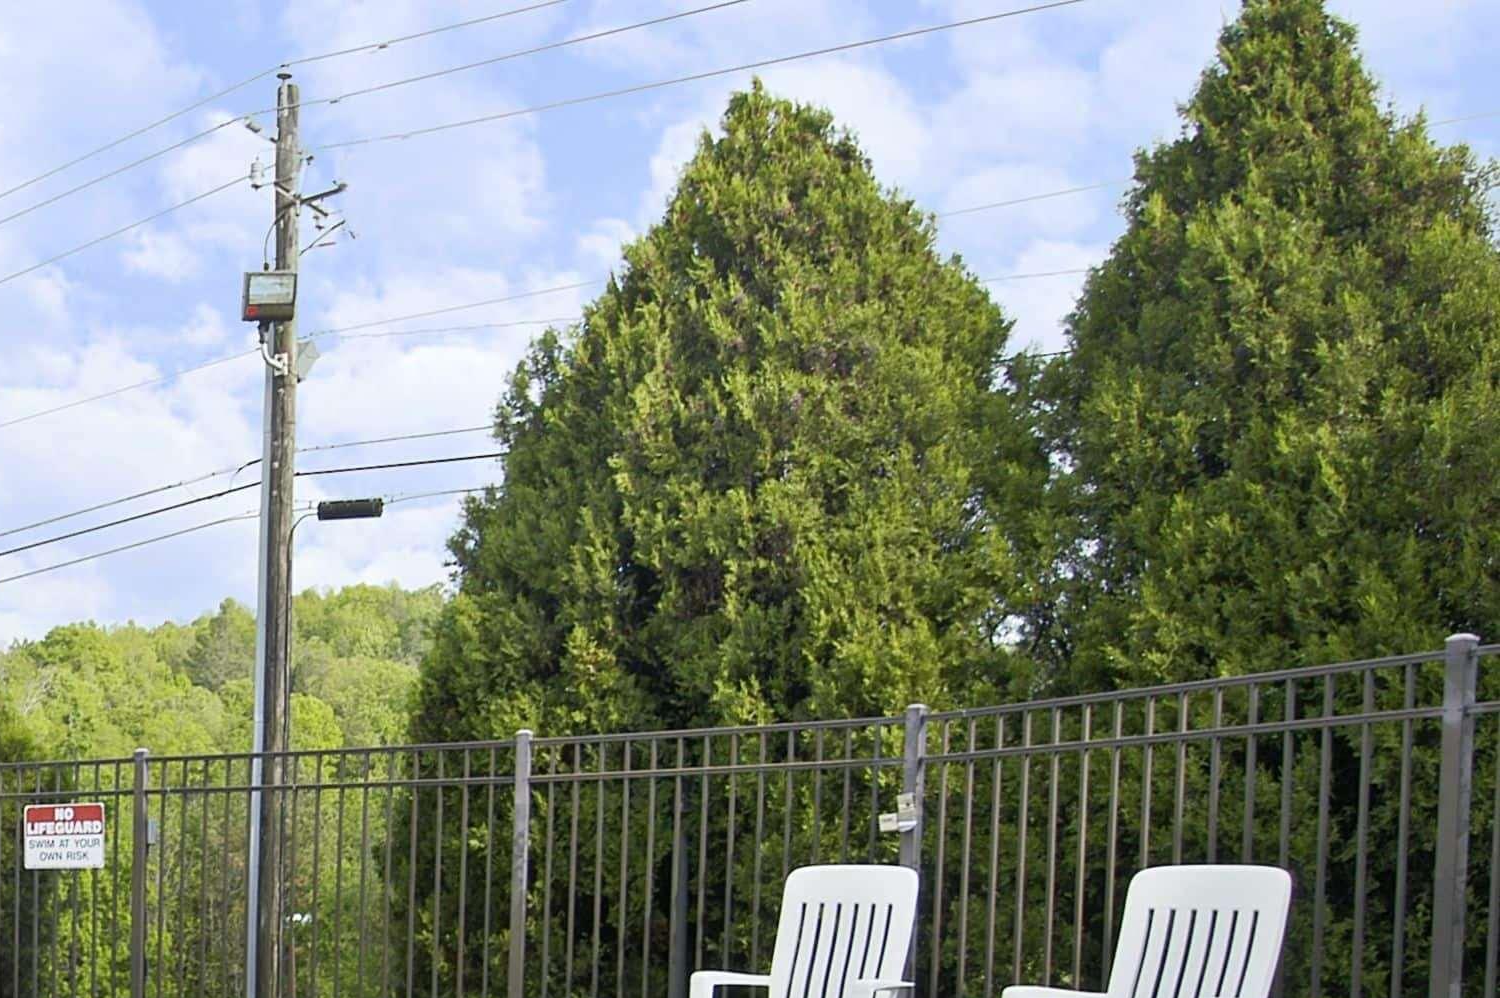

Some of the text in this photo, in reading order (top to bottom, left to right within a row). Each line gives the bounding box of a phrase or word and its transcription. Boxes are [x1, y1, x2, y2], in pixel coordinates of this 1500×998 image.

[54, 807, 74, 820] NO
[27, 821, 102, 835] LIFEGUARD
[28, 837, 101, 849] SWIM AT YOUR
[39, 851, 89, 861] OWN RISK
